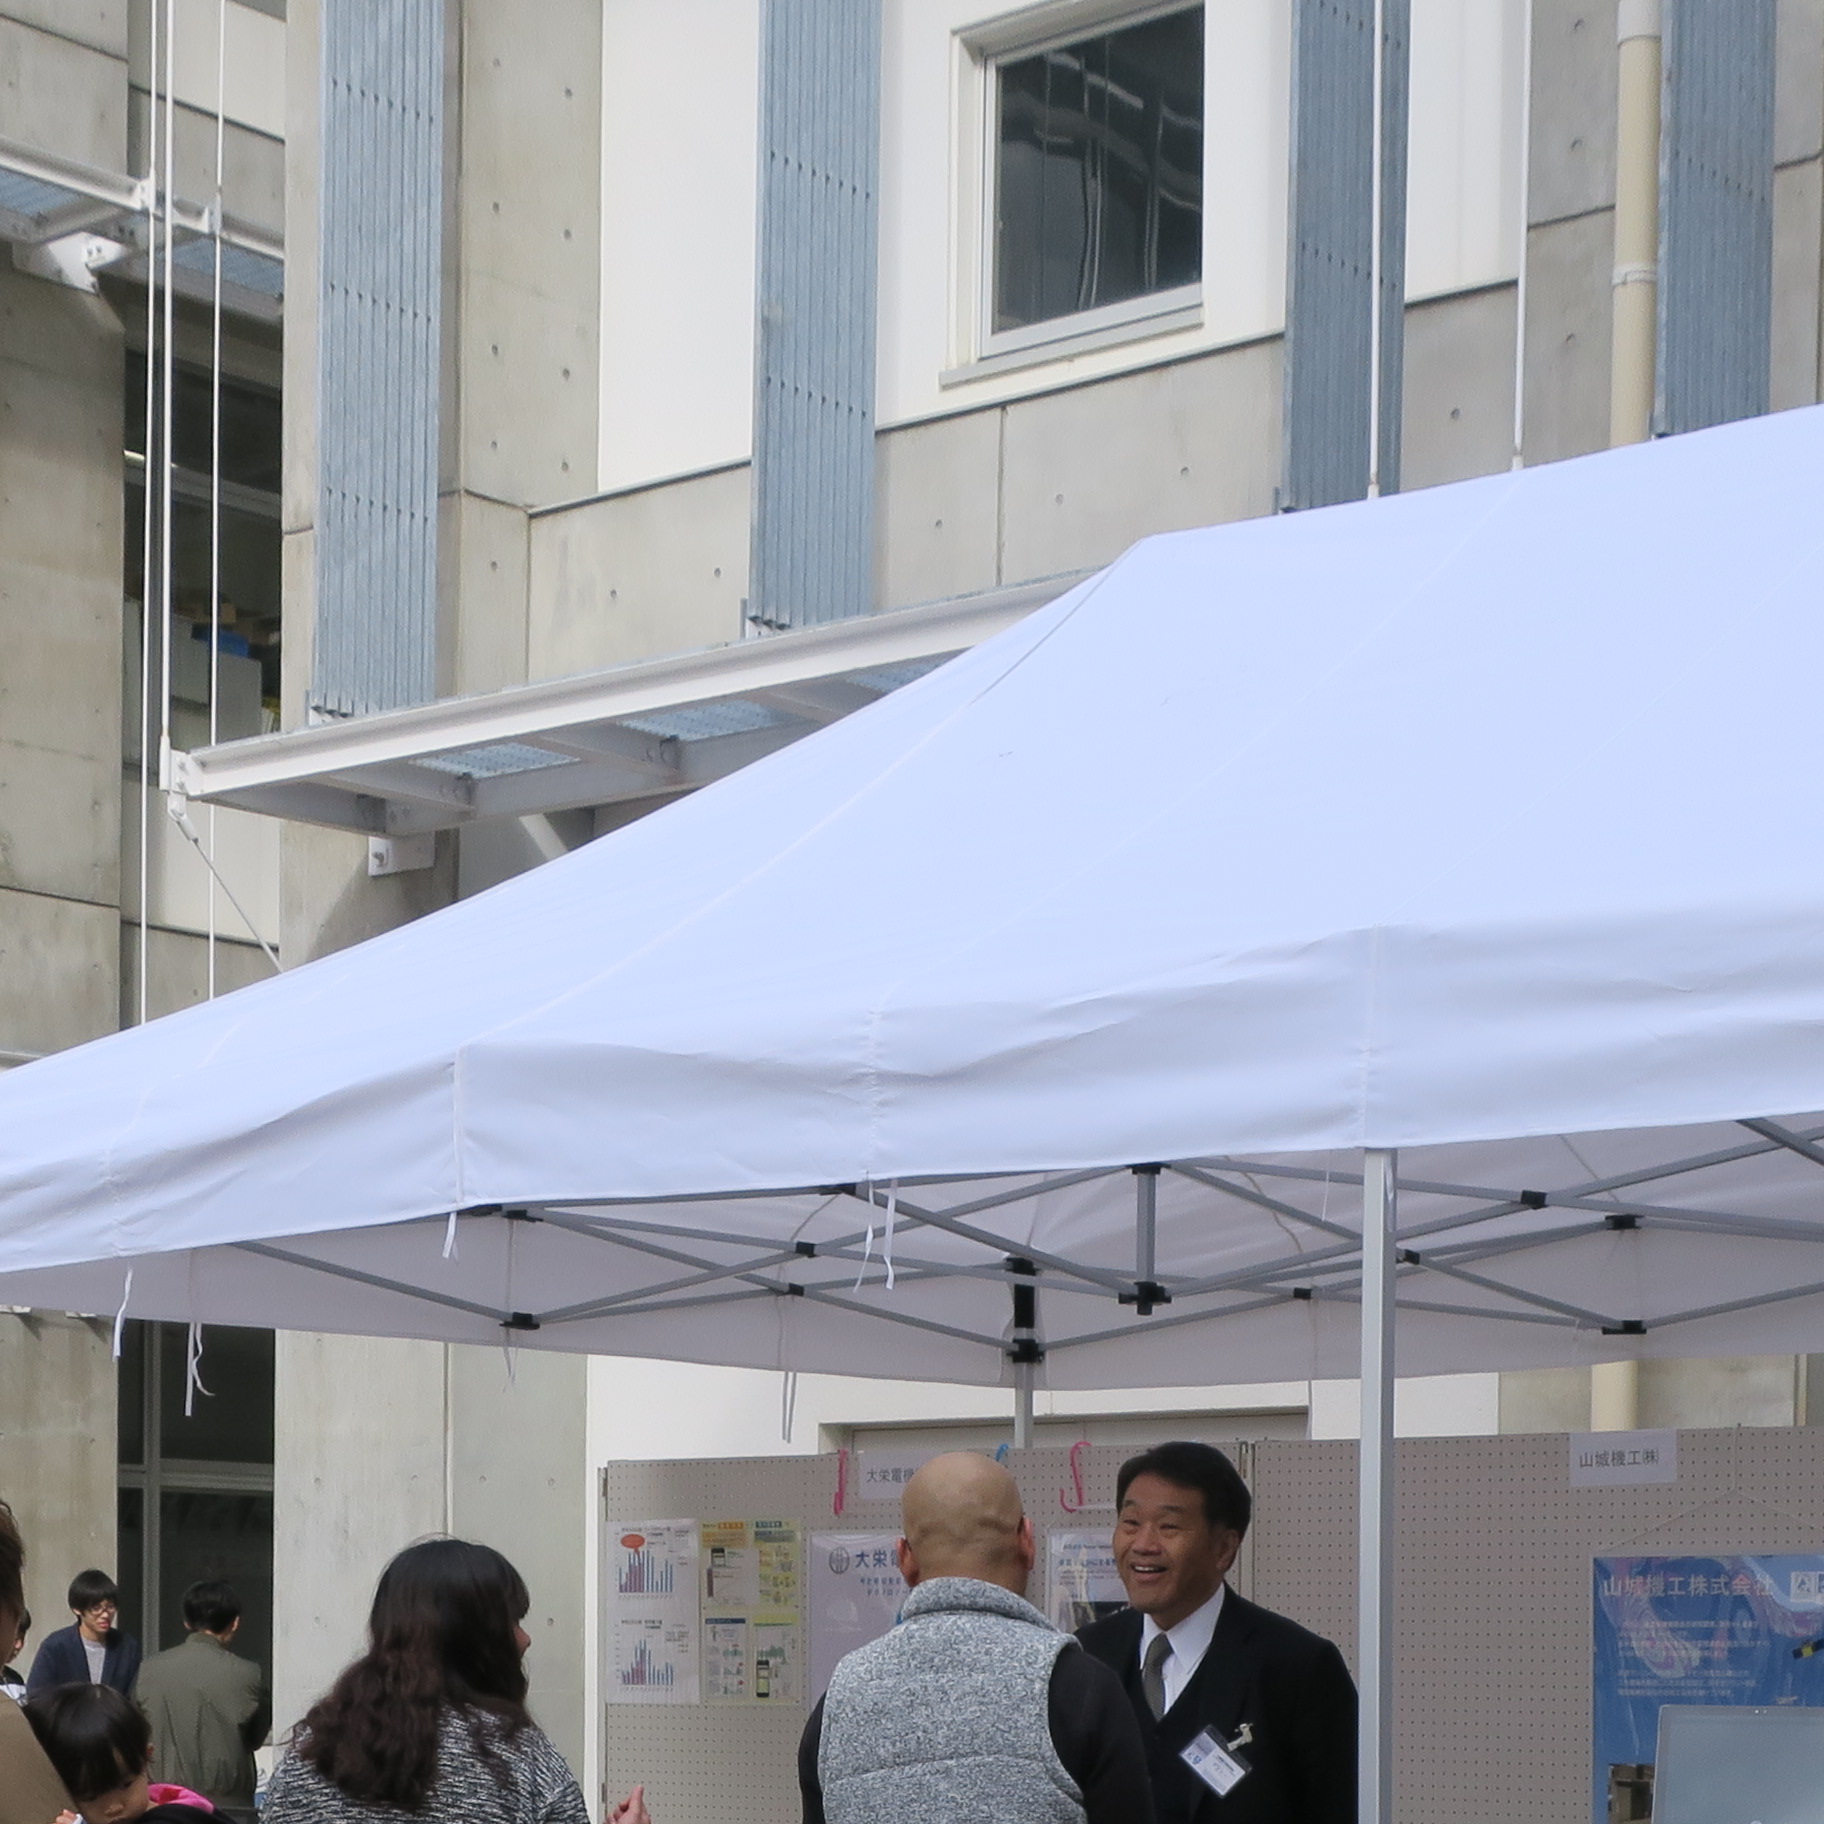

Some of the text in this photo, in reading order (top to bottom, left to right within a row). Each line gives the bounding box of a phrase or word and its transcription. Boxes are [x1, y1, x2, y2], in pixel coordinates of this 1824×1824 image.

[867, 1467, 915, 1484] 大栄電機
[1604, 1573, 1774, 1598] 山城機工株式会社
